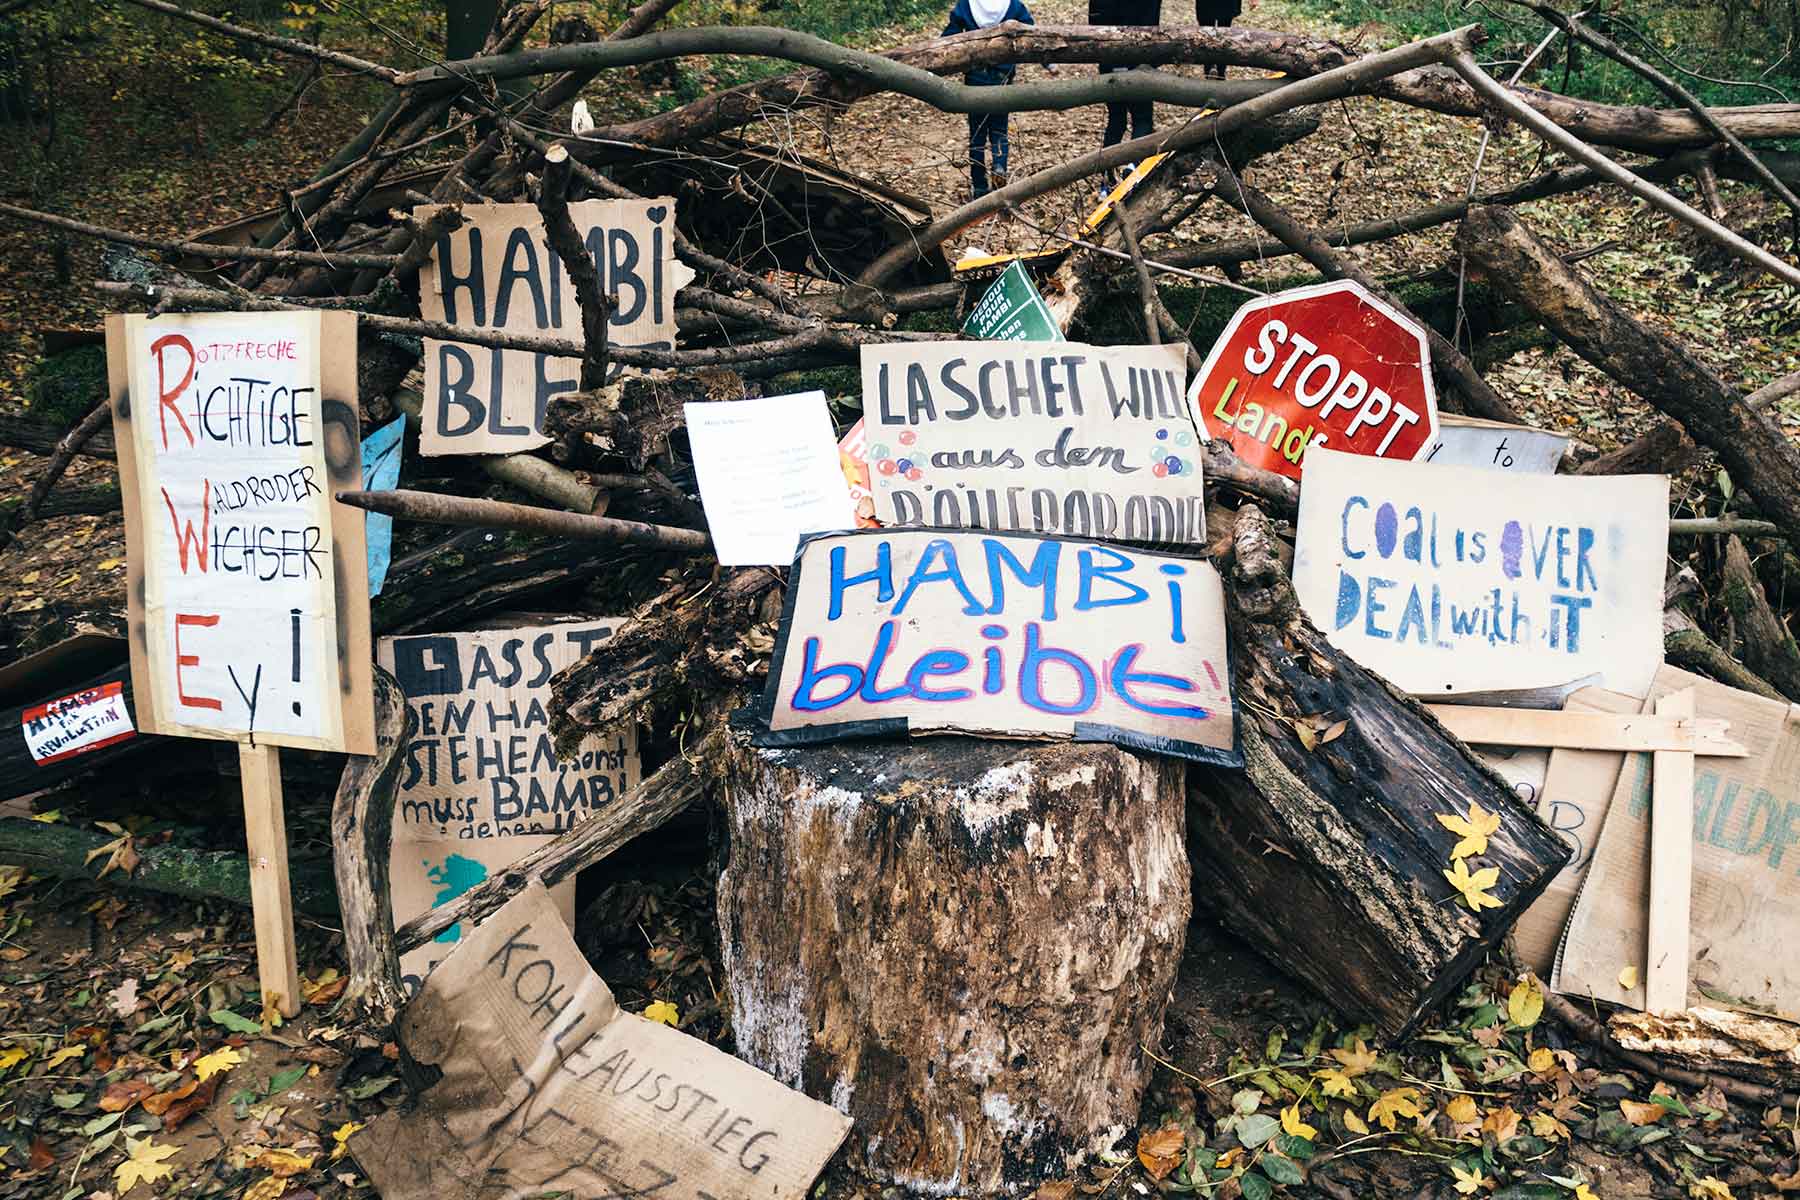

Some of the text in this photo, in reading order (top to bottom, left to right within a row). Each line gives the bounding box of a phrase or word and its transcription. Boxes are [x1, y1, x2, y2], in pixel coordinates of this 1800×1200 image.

[979, 293, 1005, 326] POUR
[979, 298, 1012, 338] HAMBI
[879, 356, 1087, 425] LASCHET
[1244, 319, 1420, 457] STOPPT
[931, 427, 1142, 475] aus dem
[1500, 519, 1598, 592] OVER
[402, 797, 478, 824] muss
